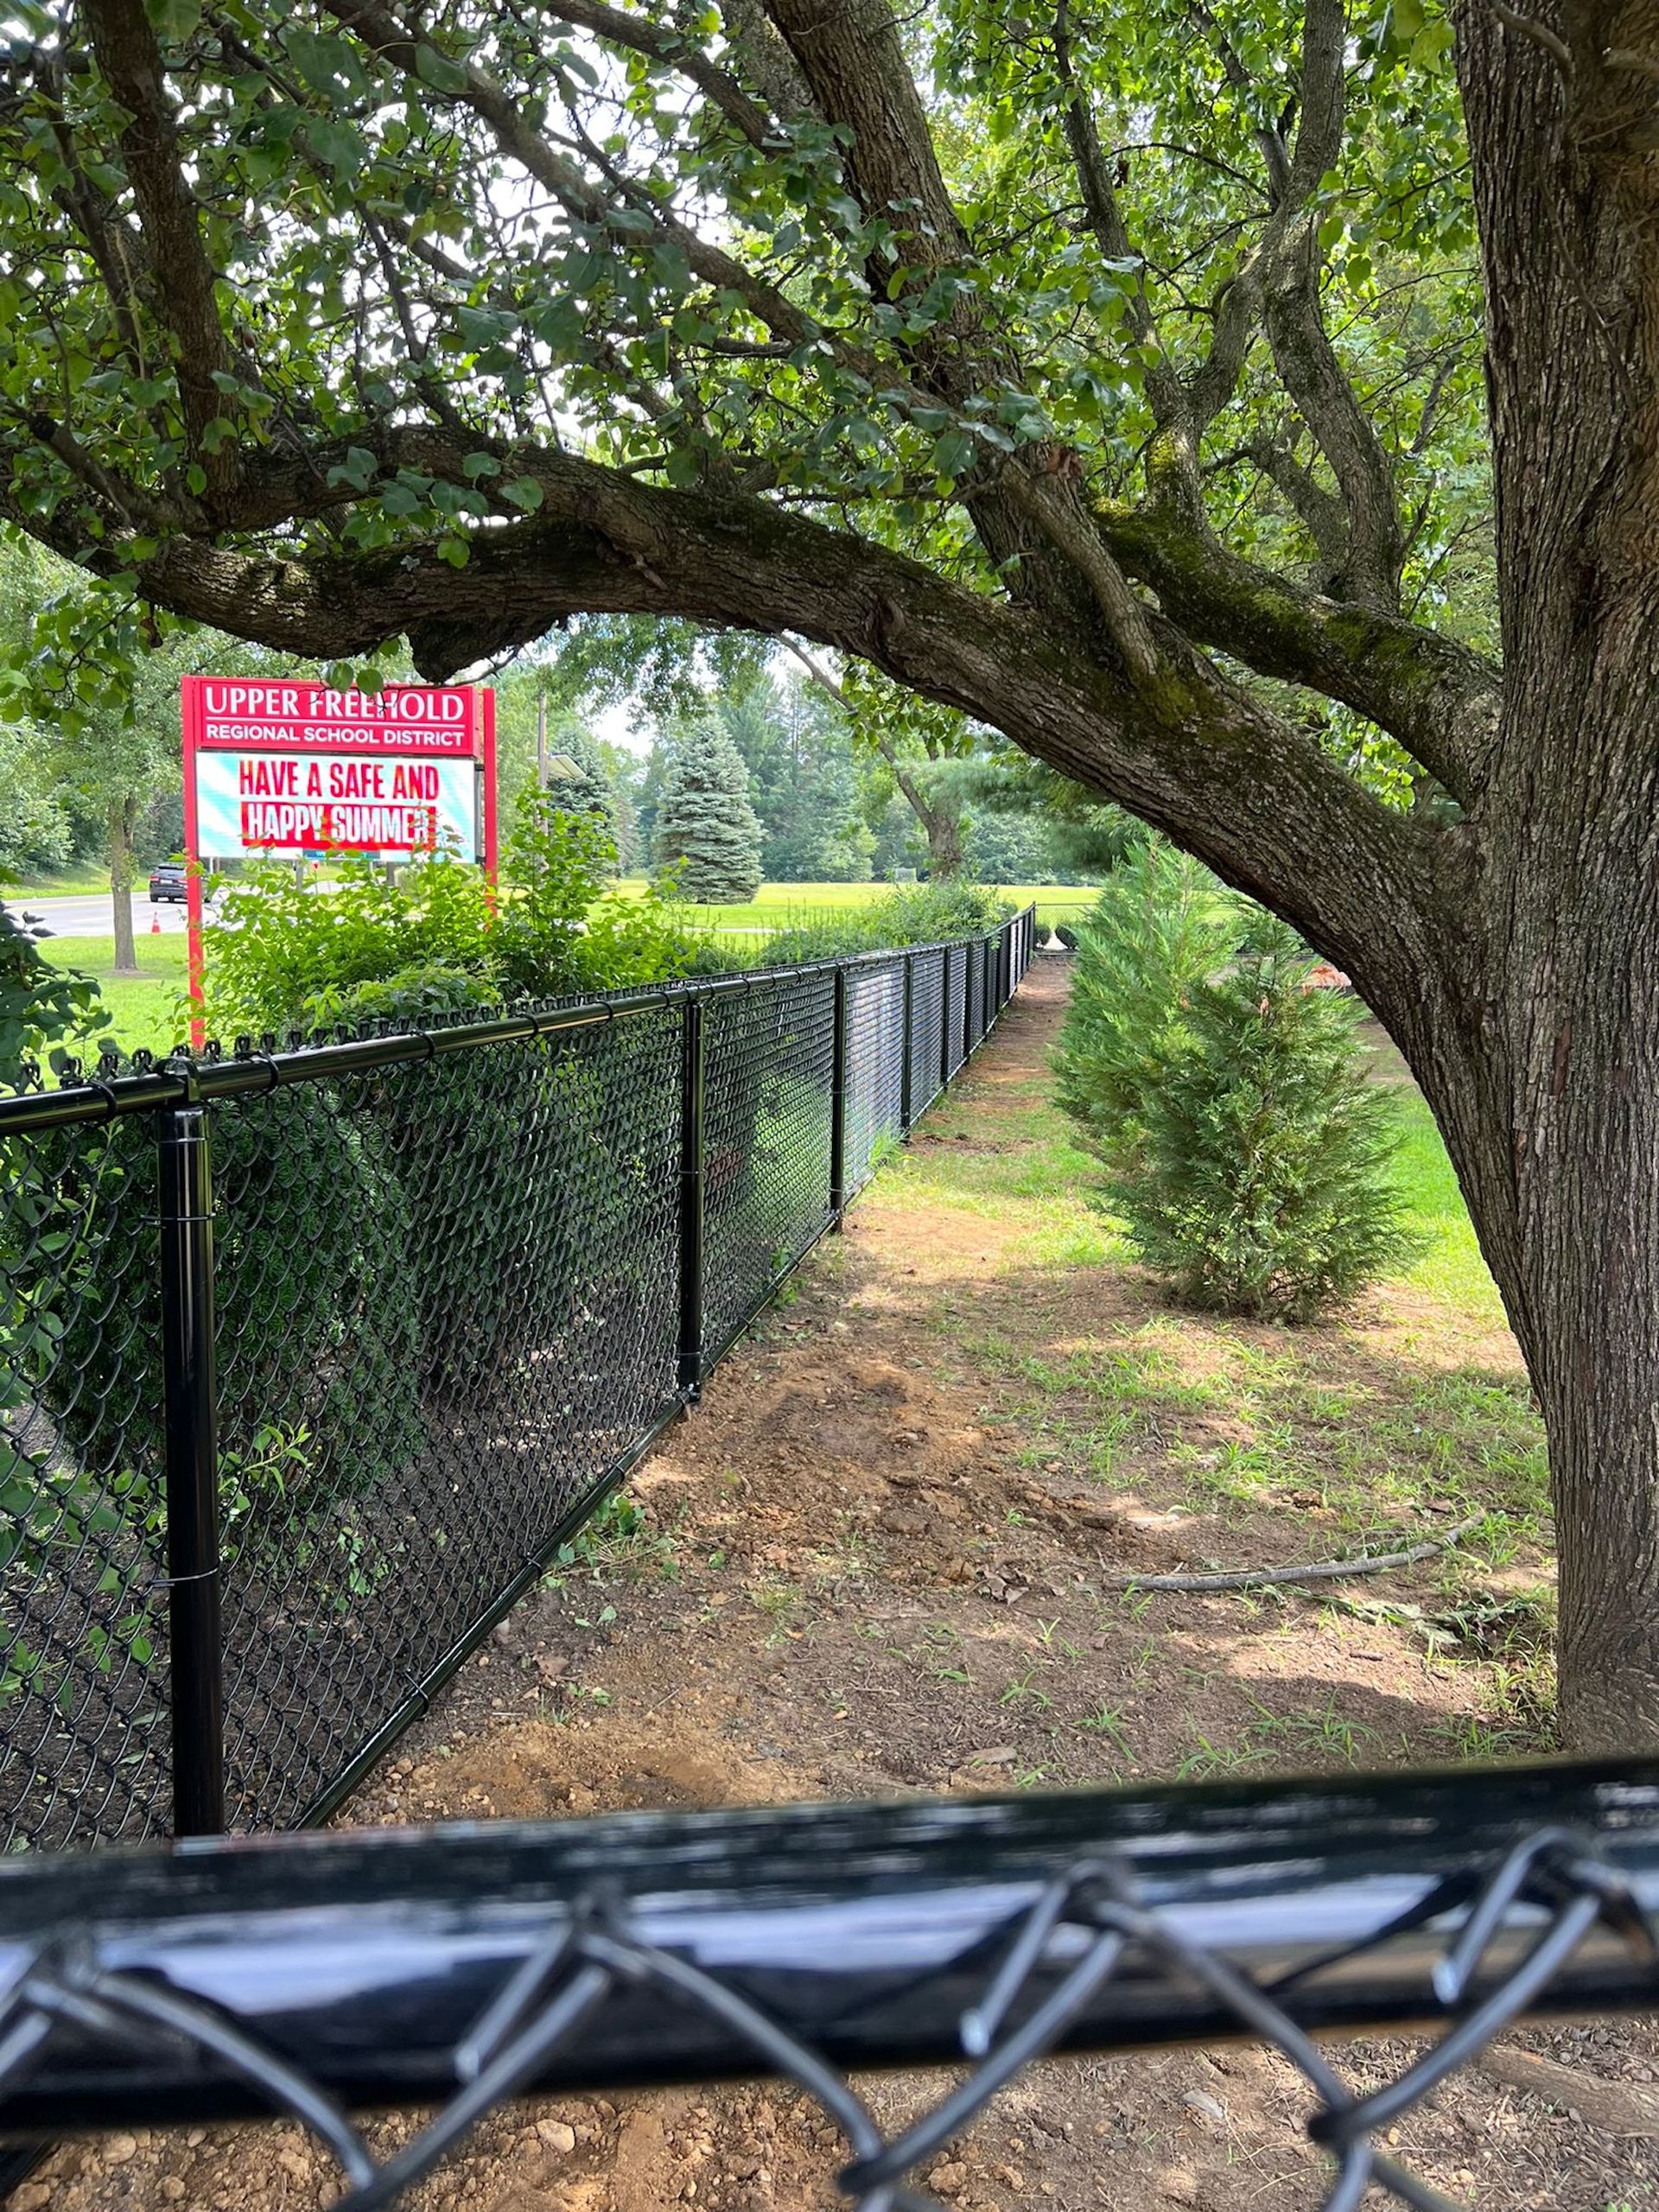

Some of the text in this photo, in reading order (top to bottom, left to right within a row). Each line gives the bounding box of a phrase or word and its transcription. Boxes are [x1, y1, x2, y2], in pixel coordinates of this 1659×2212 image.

[206, 686, 464, 721] UPPER FREEHOLD
[207, 723, 465, 747] REGIONAL SCHOOL DISTRICT
[239, 760, 439, 800] HAVE A SAFE AND
[248, 803, 429, 845] HAPPY SUMMER
